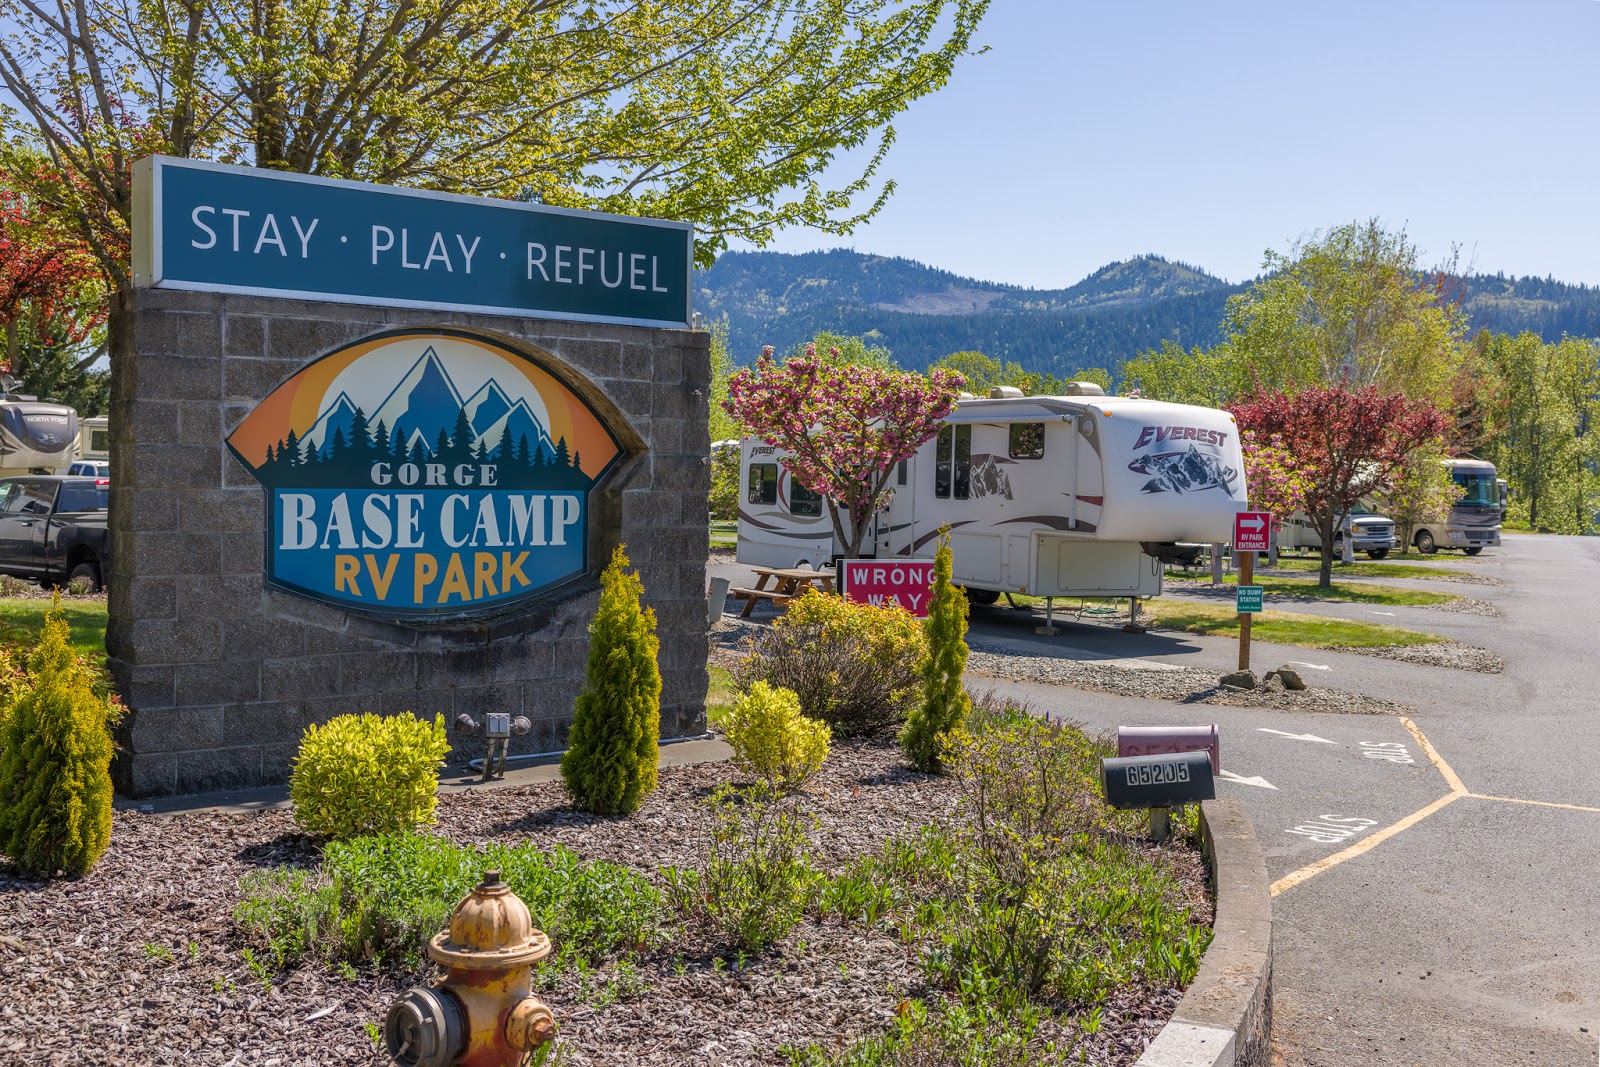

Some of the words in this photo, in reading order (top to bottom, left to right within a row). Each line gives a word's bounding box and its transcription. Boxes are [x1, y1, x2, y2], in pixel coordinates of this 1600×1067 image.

[191, 205, 319, 258] STAY
[372, 224, 481, 274] PLAY
[527, 241, 668, 293] REFUEL
[1132, 426, 1228, 450] EVEREST
[750, 446, 776, 459] EVEREST
[370, 462, 498, 486] GORGE
[279, 491, 425, 550] BASE
[440, 492, 581, 548] CAMP
[1241, 533, 1249, 541] RV
[1249, 533, 1263, 541] PARK
[334, 553, 401, 601] RV
[414, 551, 532, 604] PARK
